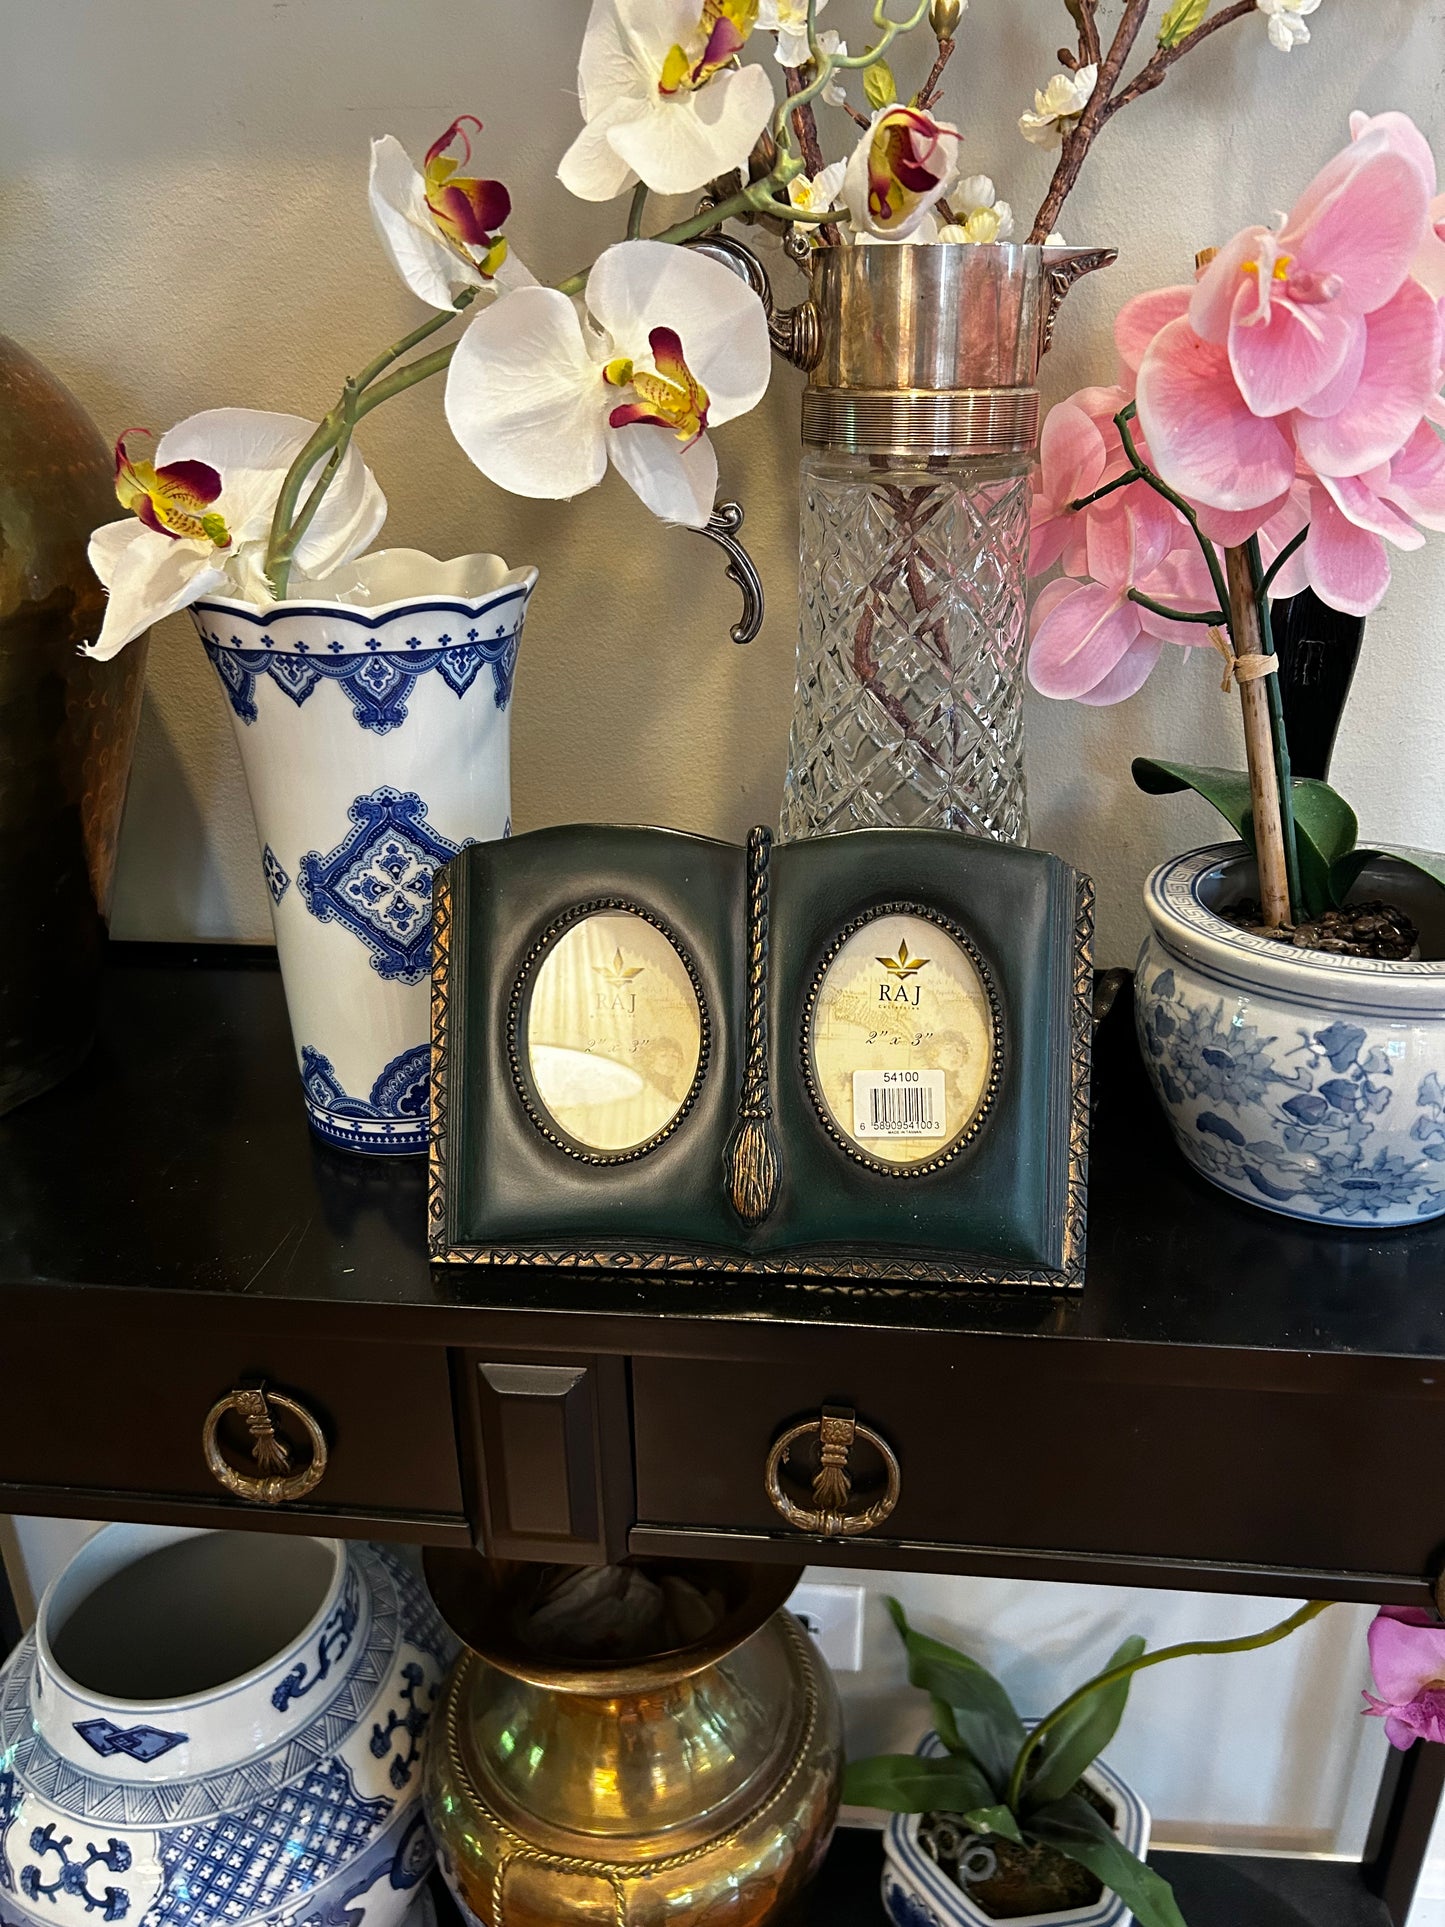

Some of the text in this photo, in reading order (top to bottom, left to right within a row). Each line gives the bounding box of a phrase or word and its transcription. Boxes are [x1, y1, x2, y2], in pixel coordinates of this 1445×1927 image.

[879, 984, 921, 1006] RAJ
[596, 993, 636, 1014] RAJ
[889, 1036, 902, 1045] x
[883, 1071, 919, 1083] 54100
[859, 1122, 866, 1131] 6
